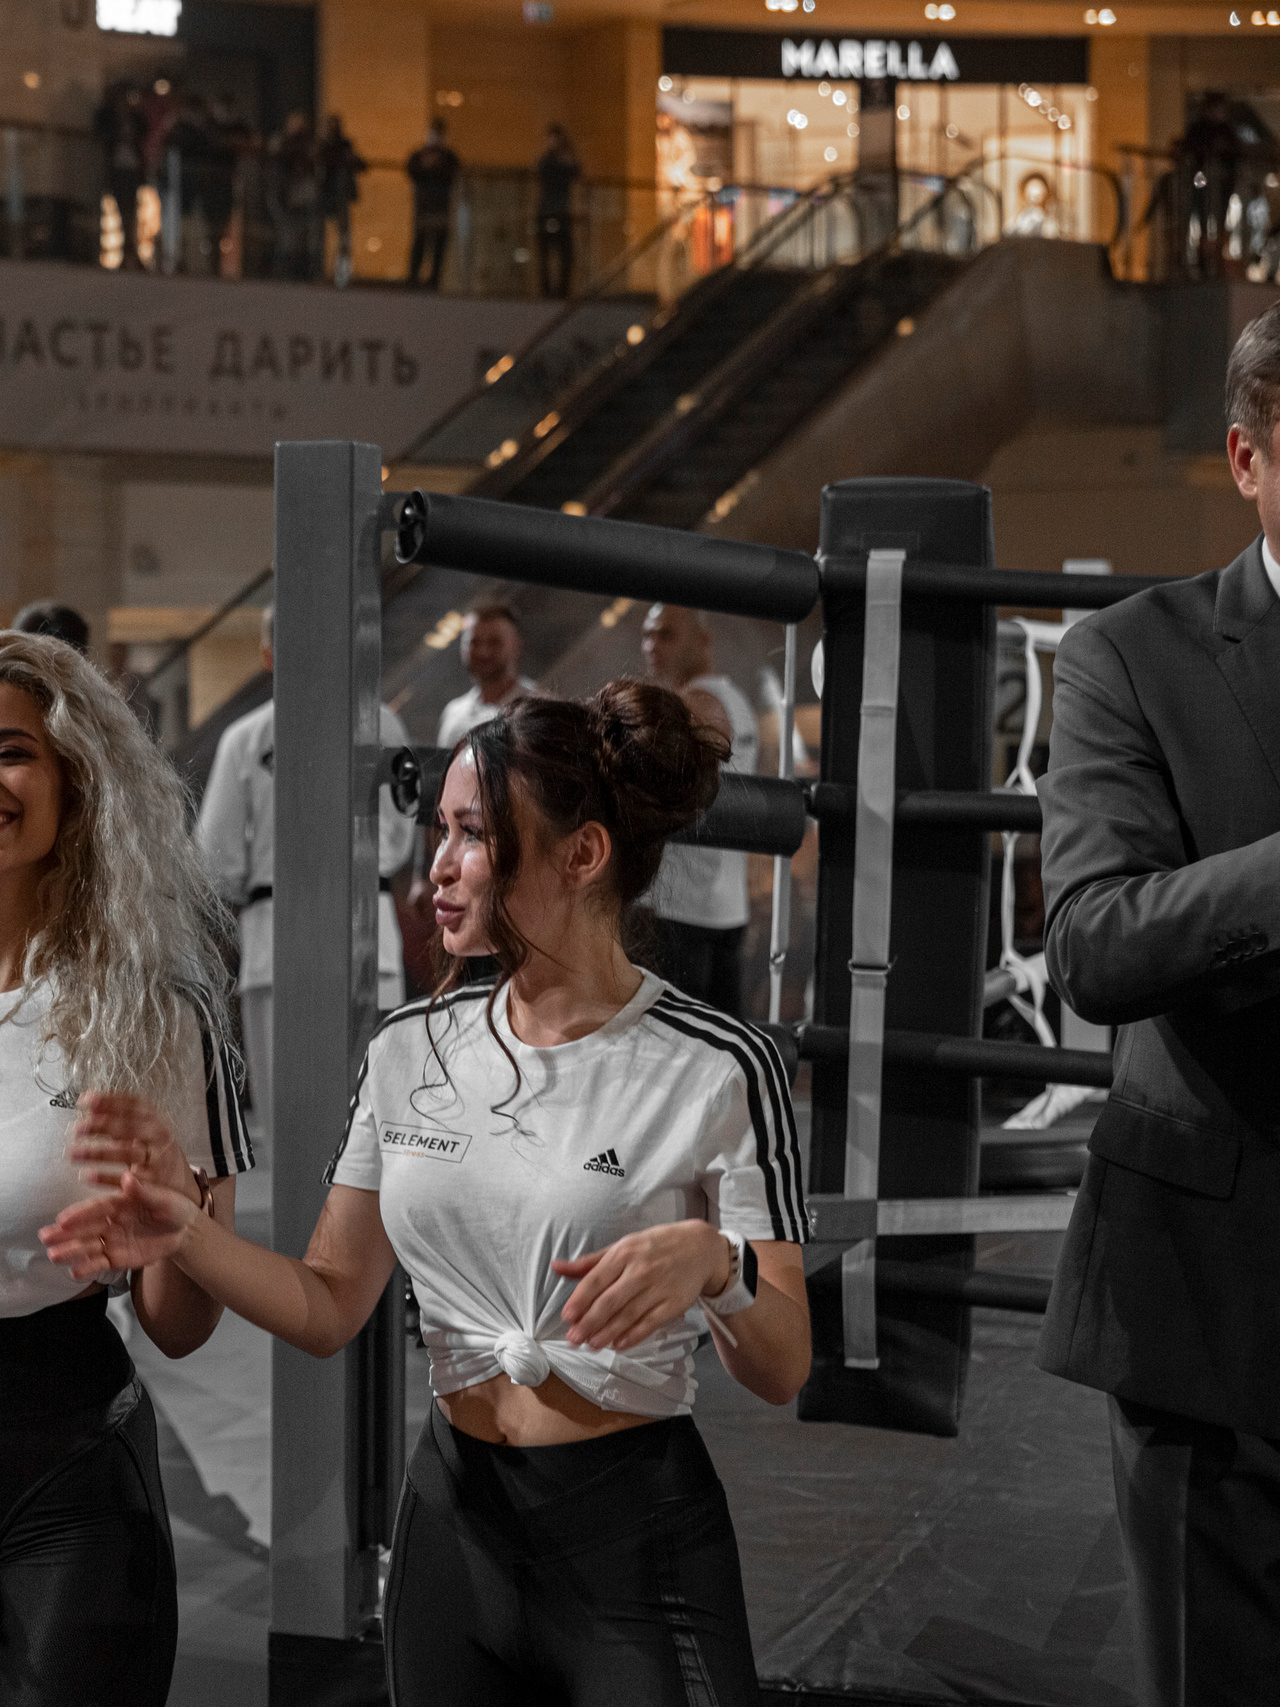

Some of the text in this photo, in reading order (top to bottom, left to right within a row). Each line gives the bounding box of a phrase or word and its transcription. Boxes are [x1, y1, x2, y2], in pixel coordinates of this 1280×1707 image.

[781, 38, 960, 80] MARELLA
[208, 329, 420, 387] ДАРИТЬ
[382, 1130, 460, 1154] 5ELEMENT
[583, 1160, 626, 1179] adidas
